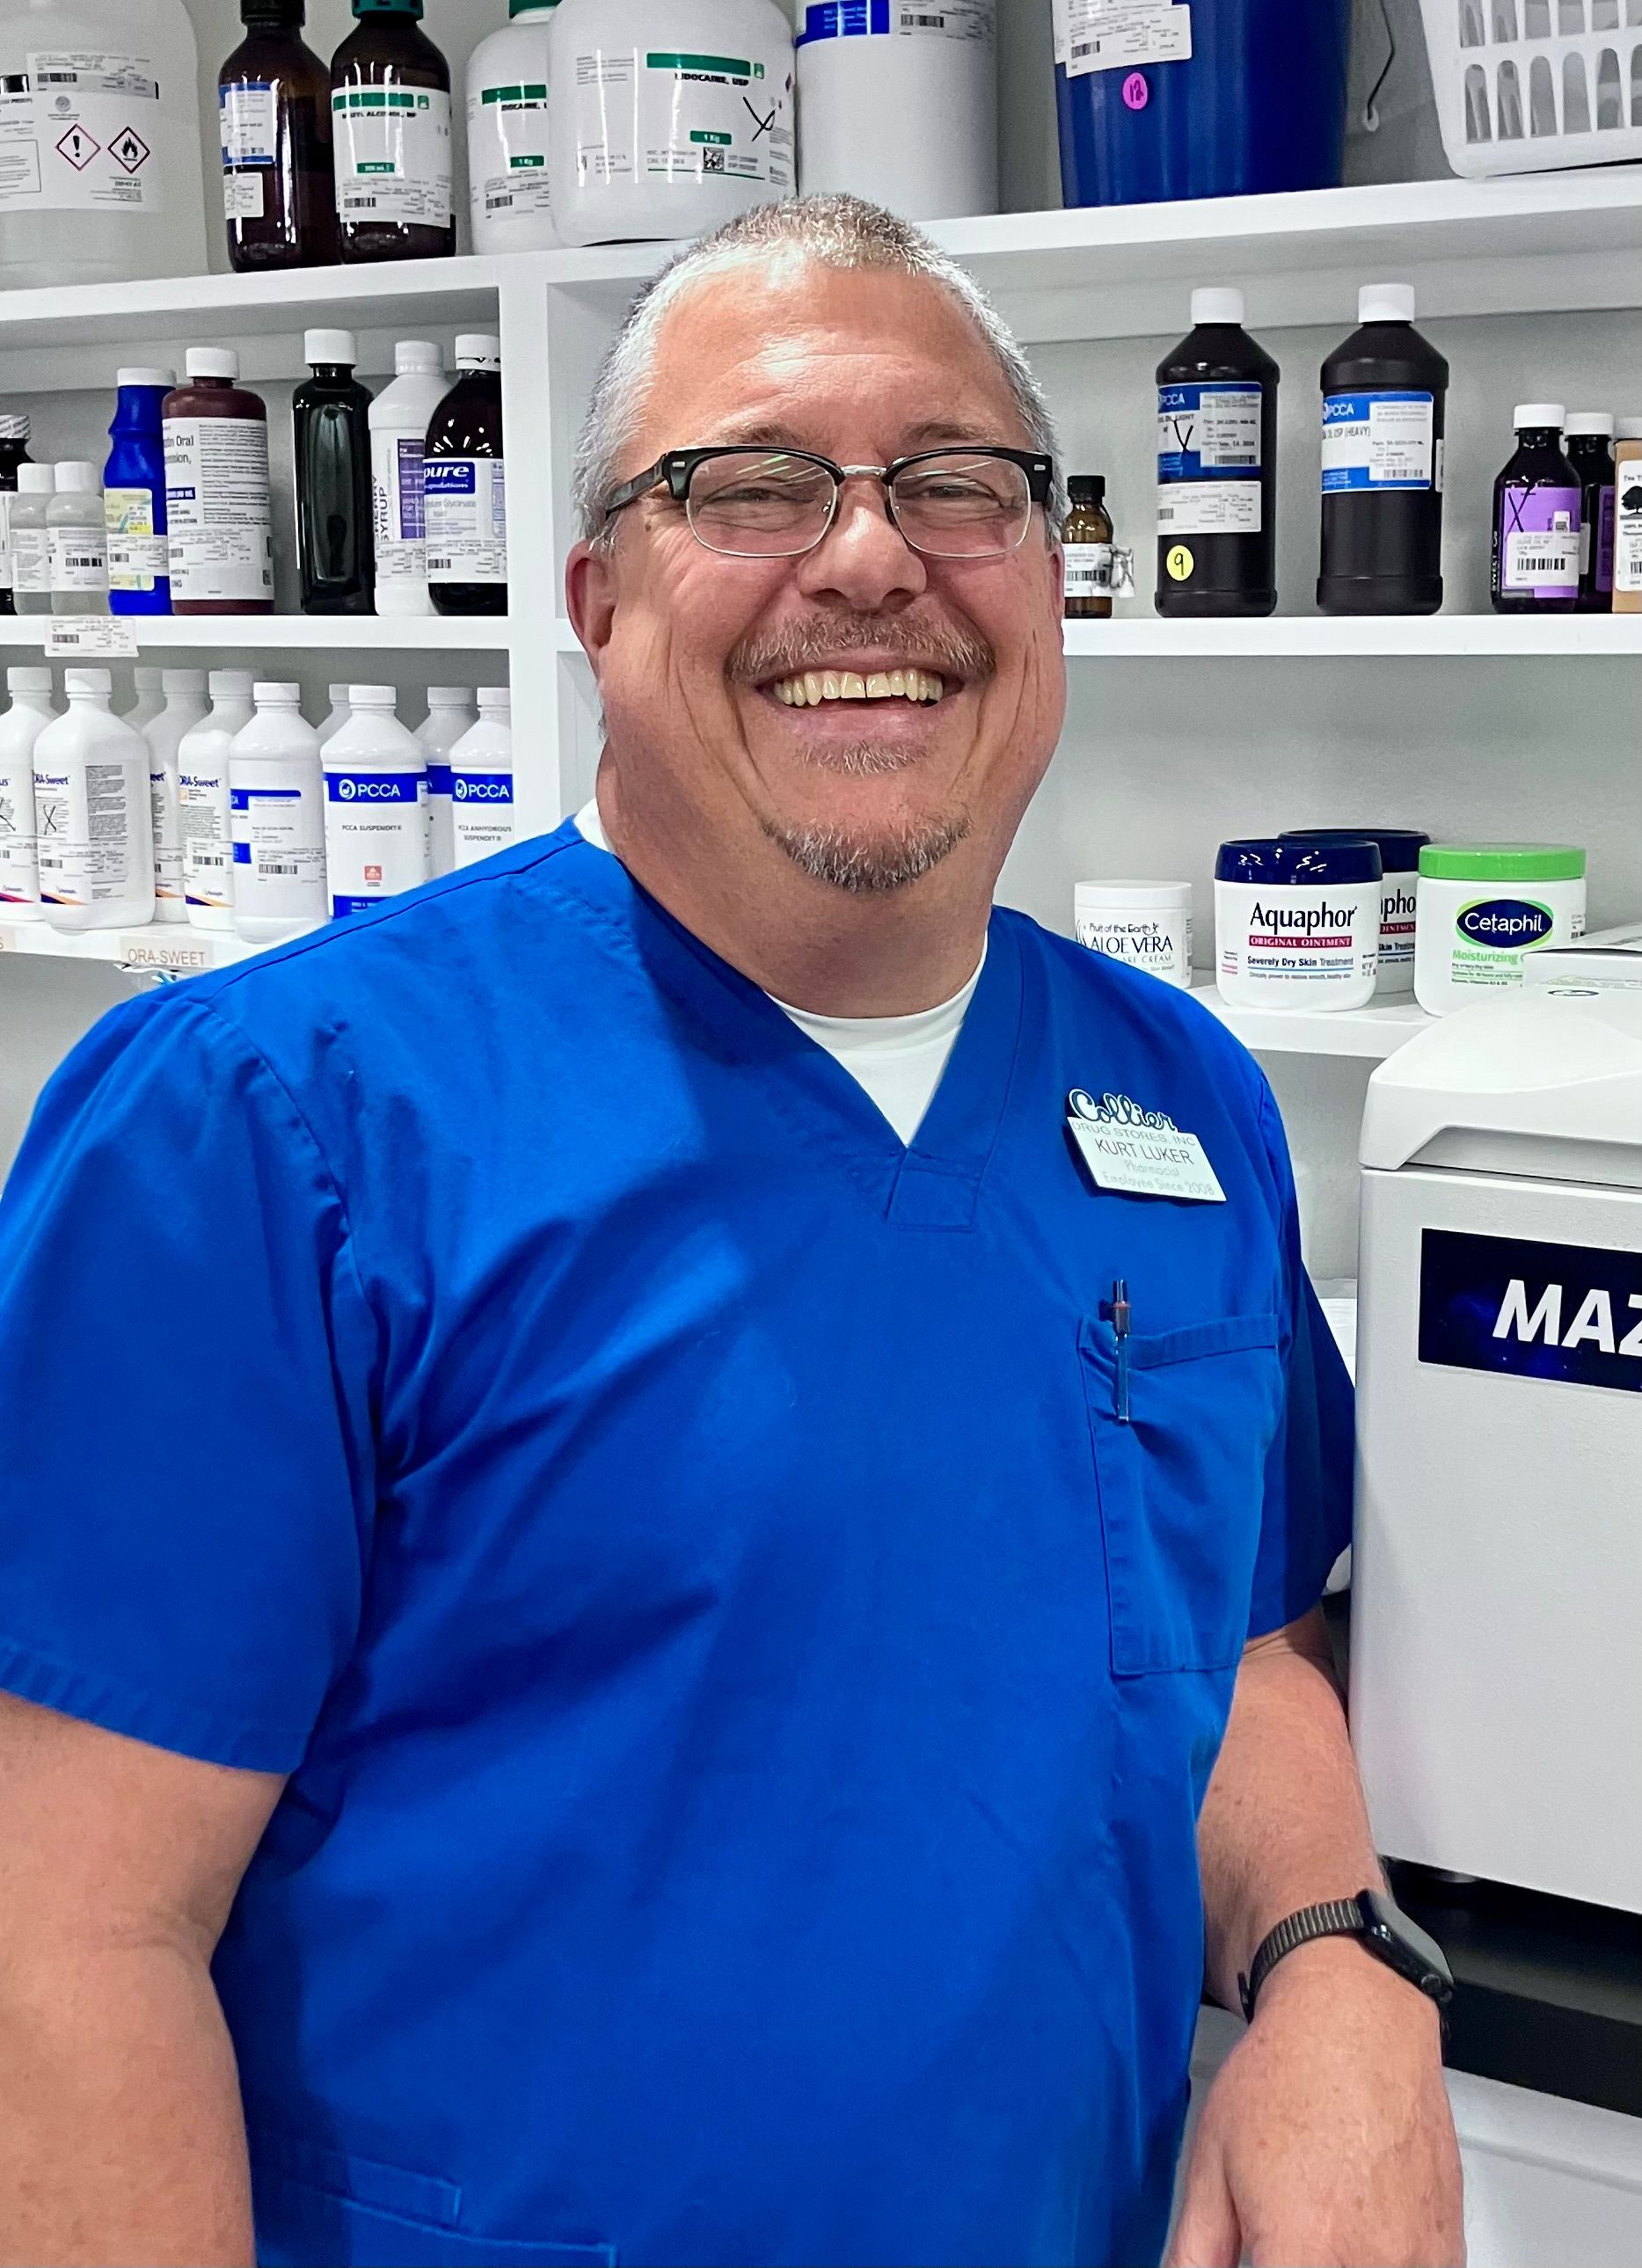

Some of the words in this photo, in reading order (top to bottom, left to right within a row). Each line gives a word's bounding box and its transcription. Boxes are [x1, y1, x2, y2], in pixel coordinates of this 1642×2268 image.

[176, 434, 194, 447] Oral
[1174, 552, 1185, 576] 9
[357, 784, 401, 798] PCCA
[467, 784, 510, 798] PCCA
[1250, 901, 1356, 936] Aquaphor
[1464, 912, 1543, 936] Cetaphil
[1131, 935, 1173, 953] VERA
[1250, 937, 1298, 947] ORIGINAL
[1301, 937, 1352, 947] OINTMENT
[128, 948, 205, 966] ORA-SWEET
[1247, 955, 1280, 967] Severely
[1281, 958, 1296, 968] Dry
[1298, 958, 1317, 966] Skin
[1319, 957, 1354, 966] Treatment
[1452, 949, 1519, 966] Moisturizing
[1069, 1090, 1177, 1131] Collier
[1072, 1122, 1111, 1135] DRUG
[1094, 1139, 1140, 1158] KURT
[1140, 1144, 1194, 1165] LUKER
